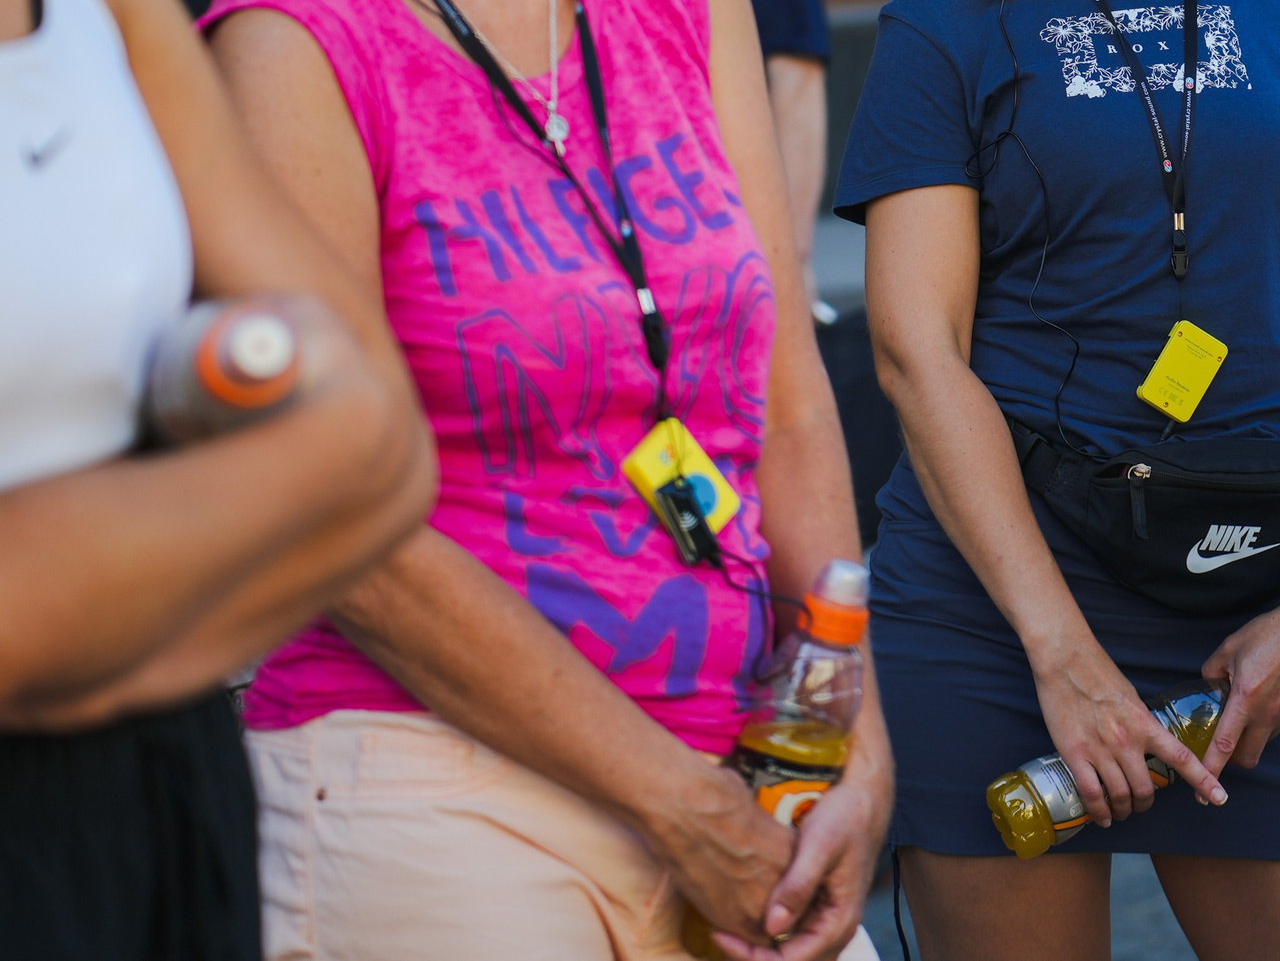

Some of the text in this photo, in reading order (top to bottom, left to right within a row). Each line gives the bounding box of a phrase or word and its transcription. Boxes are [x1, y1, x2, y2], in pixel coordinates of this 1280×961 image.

[1107, 41, 1170, 54] ROX
[1141, 81, 1168, 158] www.crystal-sound.com
[414, 133, 742, 298] HILFIGE
[1199, 524, 1261, 552] NIKE
